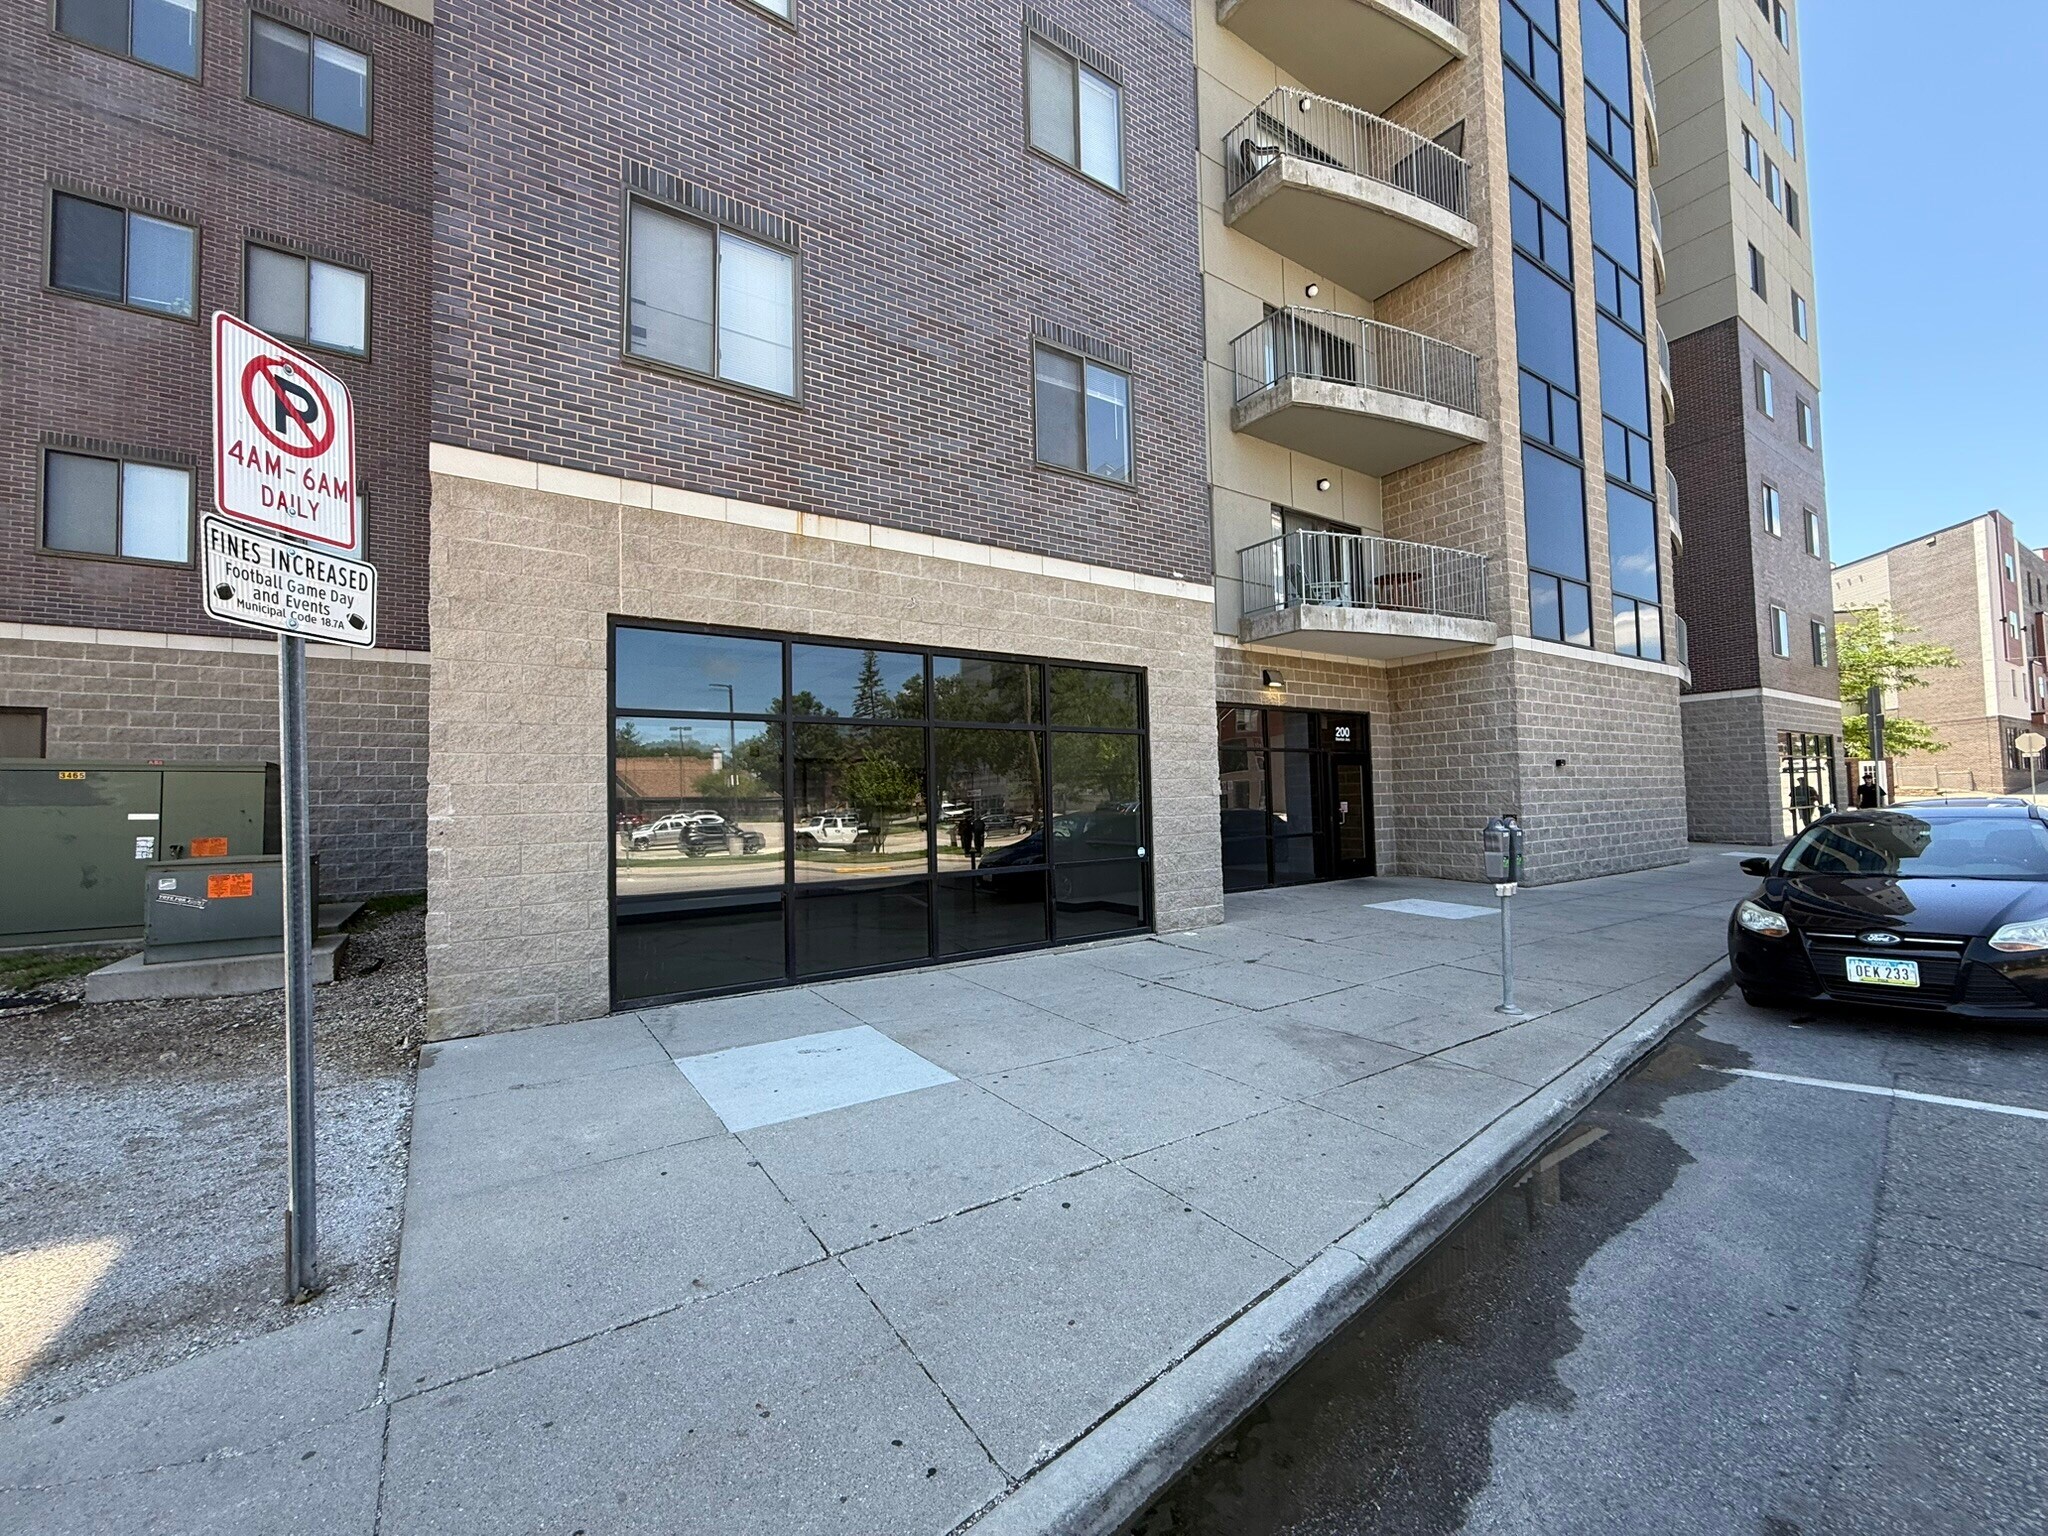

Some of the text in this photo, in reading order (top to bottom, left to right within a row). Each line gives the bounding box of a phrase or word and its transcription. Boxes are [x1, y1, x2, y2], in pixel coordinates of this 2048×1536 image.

[274, 374, 318, 434] P
[262, 484, 319, 521] DAILY
[211, 527, 261, 564] FINES
[226, 562, 354, 609] Football Game Day
[271, 548, 368, 592] INCREASED
[237, 598, 345, 630] Municipal Code 18.7A
[253, 588, 330, 616] and Events
[1335, 726, 1350, 737] 200
[60, 771, 85, 779] 3465
[1867, 933, 1890, 942] Ford
[1885, 967, 1909, 981] 233
